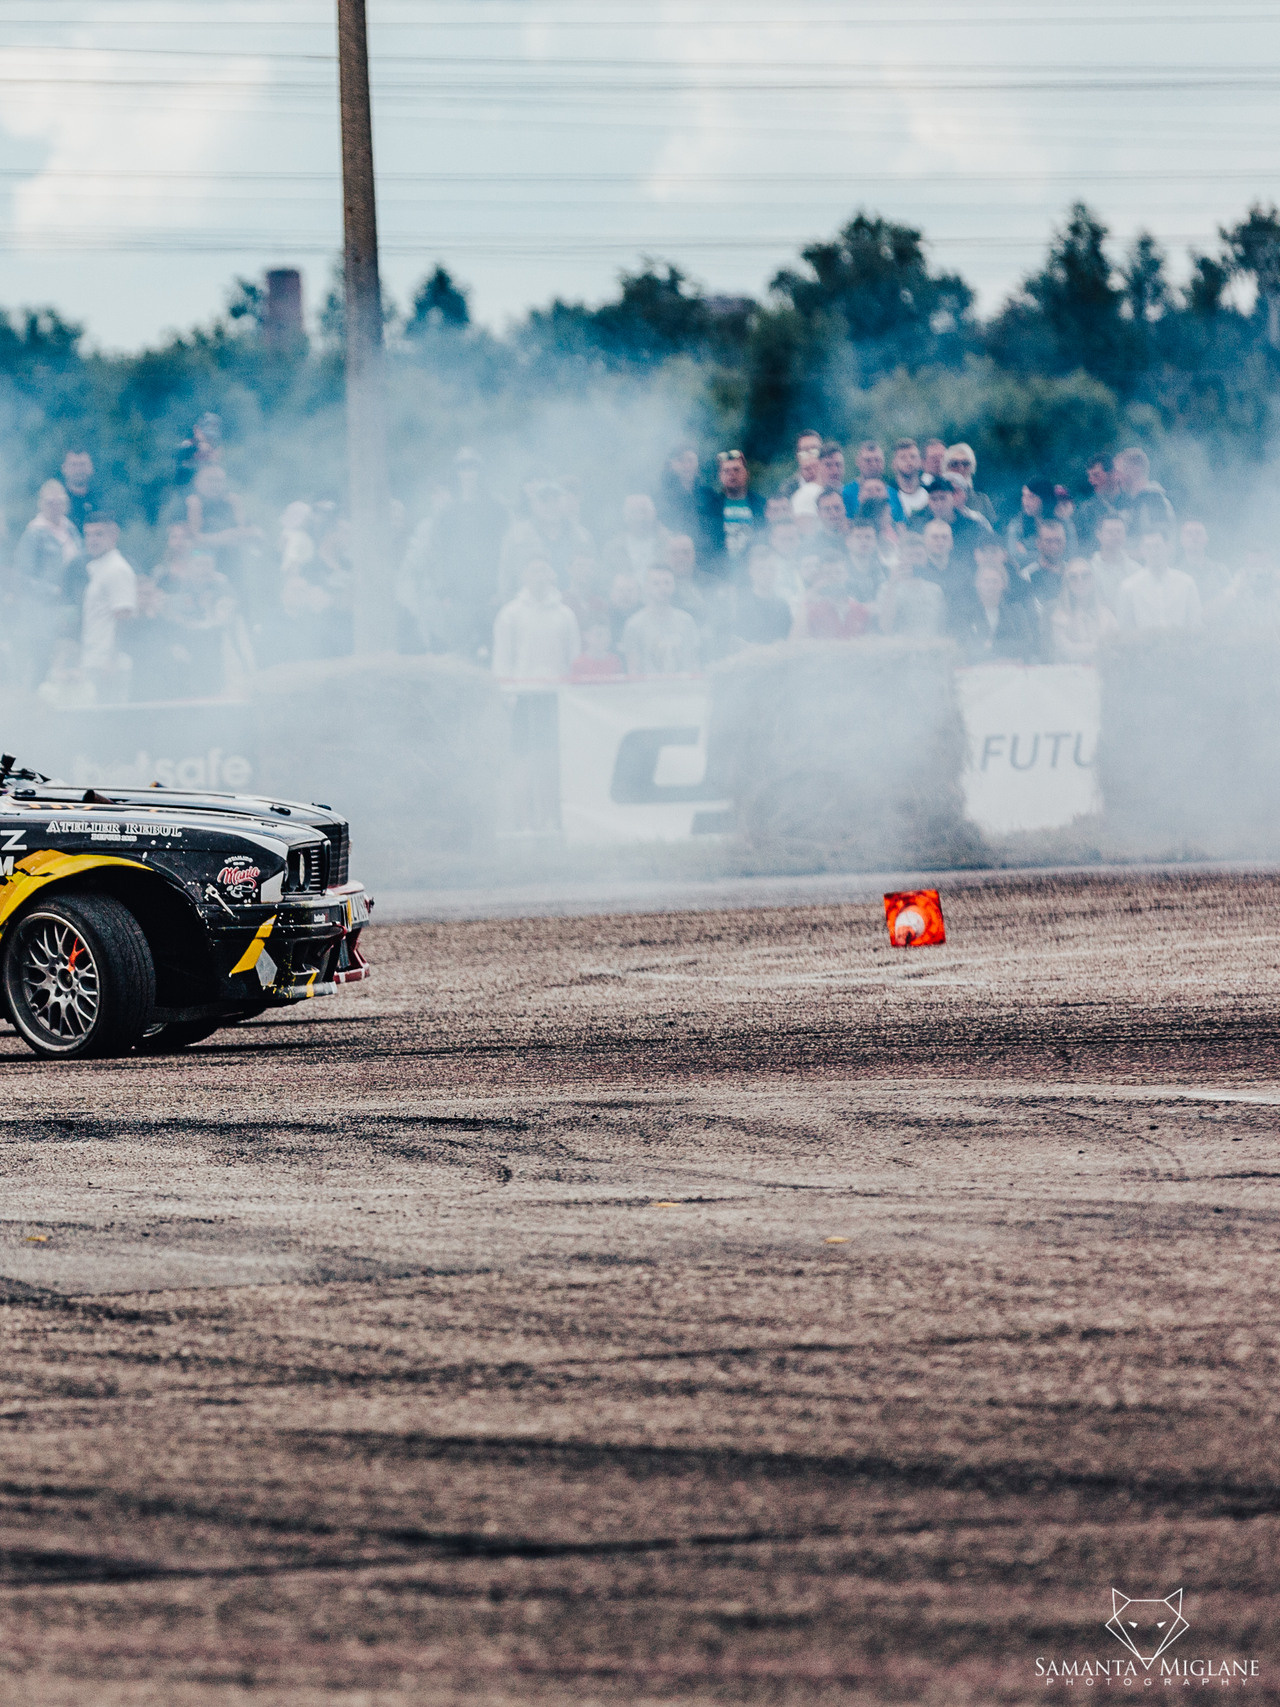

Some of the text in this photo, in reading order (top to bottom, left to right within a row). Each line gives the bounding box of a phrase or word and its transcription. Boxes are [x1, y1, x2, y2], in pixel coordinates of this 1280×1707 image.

[963, 731, 1092, 771] FUTU
[46, 821, 182, 837] ATELIER REBUL
[217, 866, 260, 886] Mania
